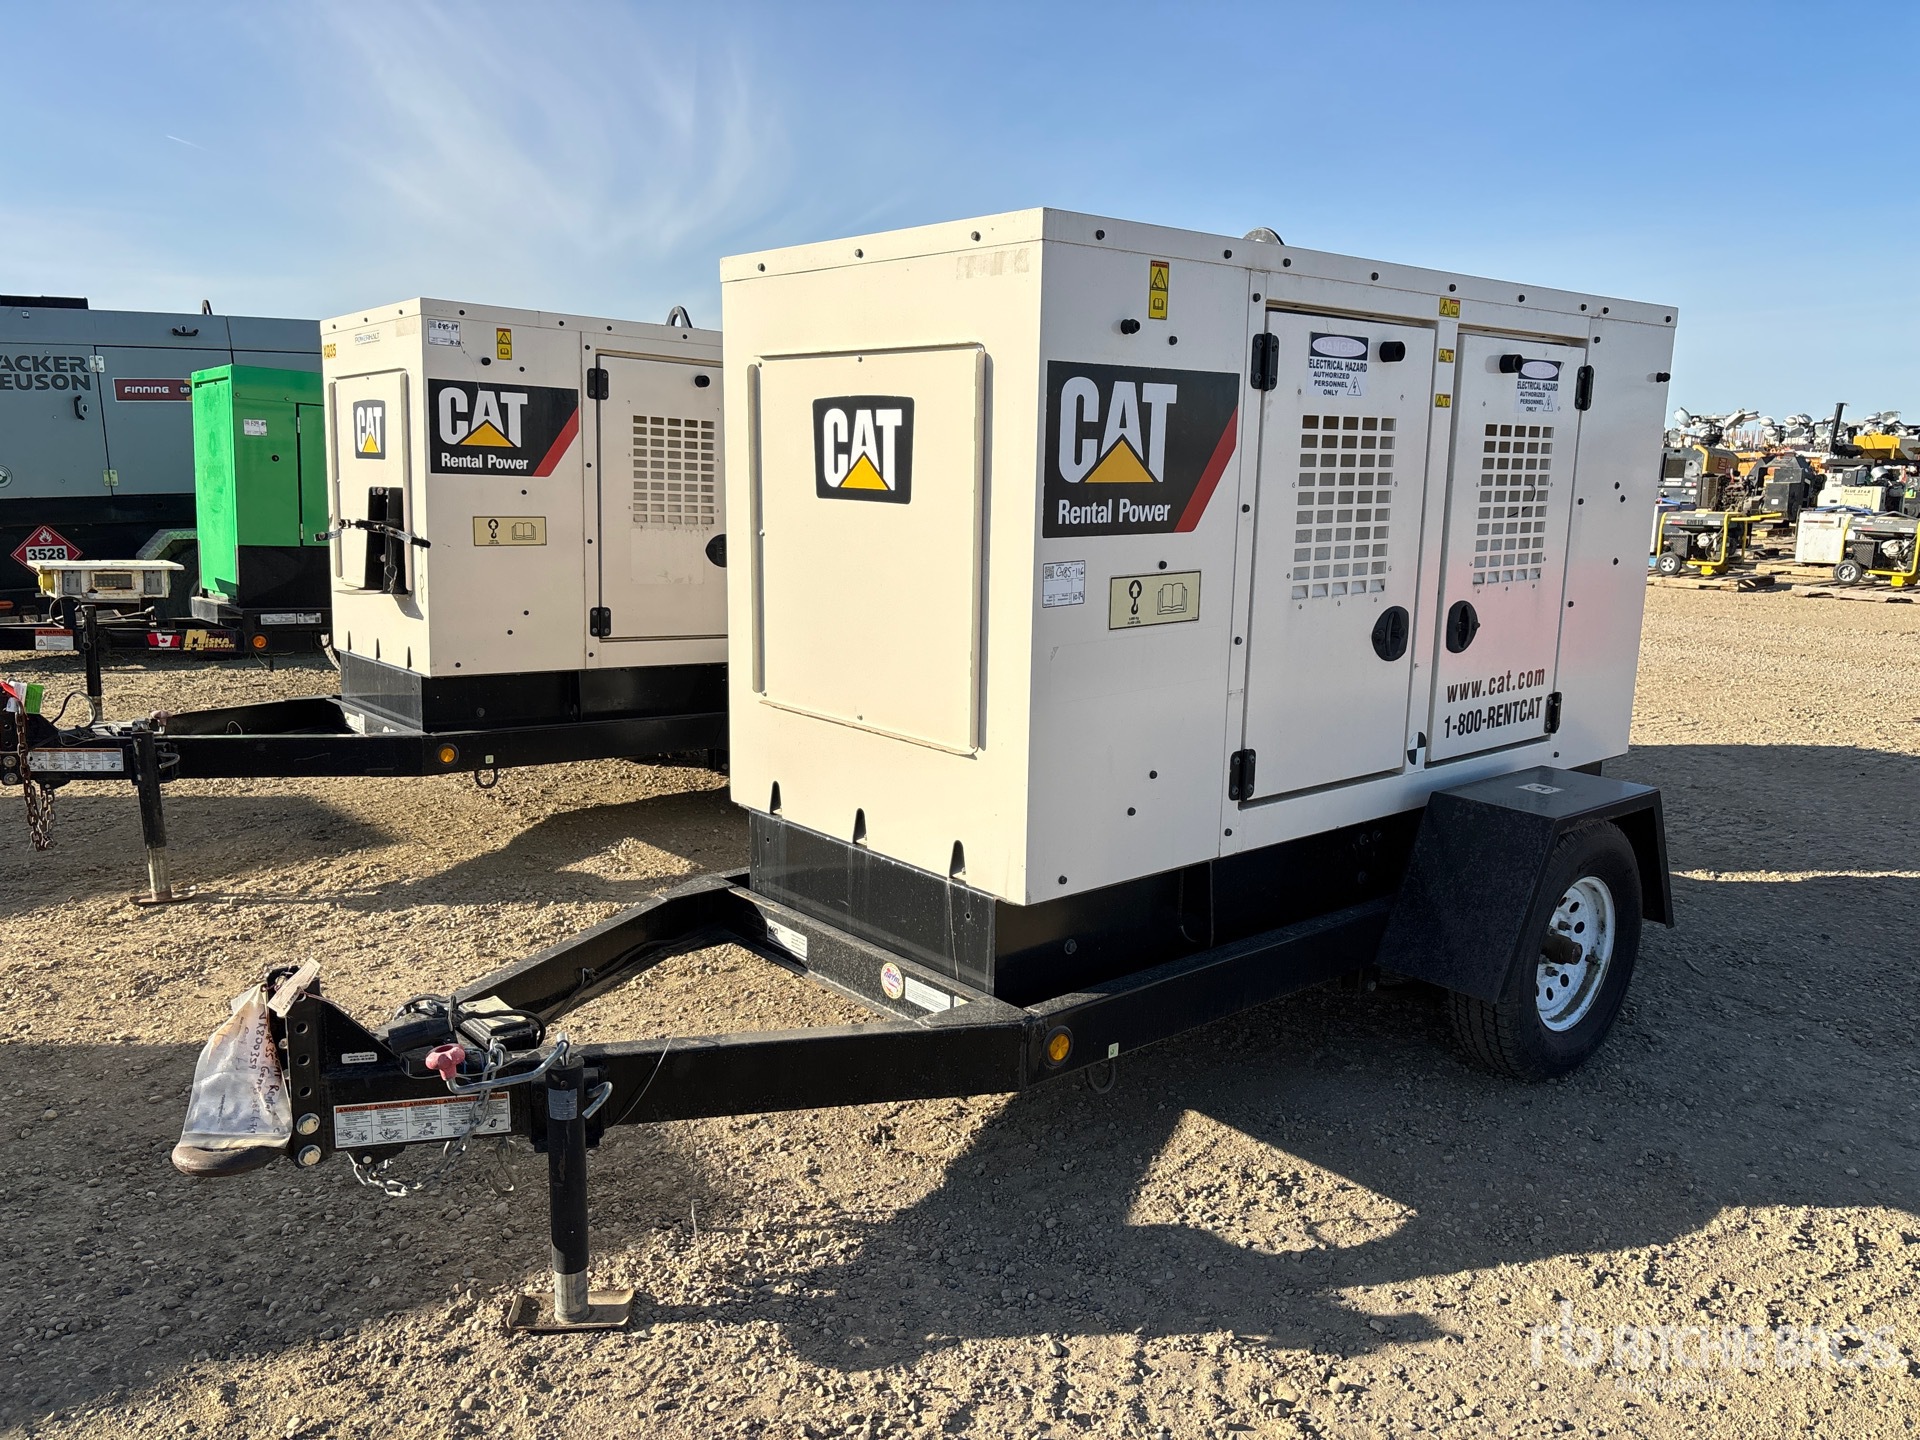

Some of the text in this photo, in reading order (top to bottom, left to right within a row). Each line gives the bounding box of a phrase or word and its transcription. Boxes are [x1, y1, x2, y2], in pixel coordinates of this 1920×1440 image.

[0, 355, 89, 373] ACKER
[1309, 358, 1368, 372] ELECTRICAL HAZARD
[1313, 371, 1350, 379] AUTHORIZED
[1314, 380, 1348, 388] PERSONNEL
[124, 386, 170, 394] FINNING
[1517, 381, 1559, 391] ELECTRICAL HAZARD
[438, 386, 528, 448] CAT
[356, 406, 382, 453] CAT
[1058, 376, 1178, 483] CAT
[823, 408, 902, 491] CAT
[441, 452, 529, 470] Rental Power
[1058, 498, 1171, 524] Rental Power
[28, 547, 66, 560] 3528
[1446, 668, 1545, 704] www.cat.com
[1444, 696, 1543, 739] 1-800-RENTCAT
[412, 1099, 438, 1107] WARNING
